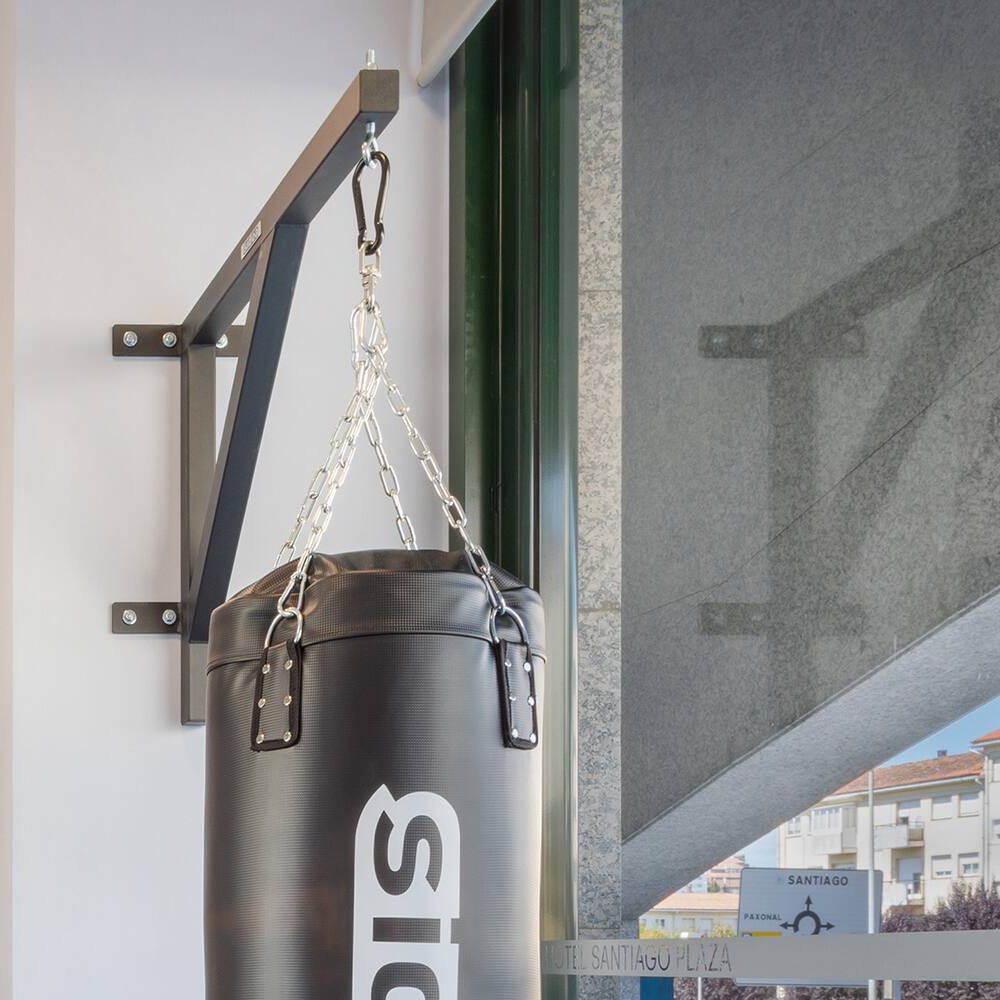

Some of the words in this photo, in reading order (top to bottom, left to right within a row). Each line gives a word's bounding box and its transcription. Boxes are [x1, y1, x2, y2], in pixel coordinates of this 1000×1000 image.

[788, 875, 849, 886] SANTIAGO
[743, 913, 782, 921] PAXONAL
[591, 944, 671, 971] SANTIAGO
[676, 944, 732, 972] PLAZA
